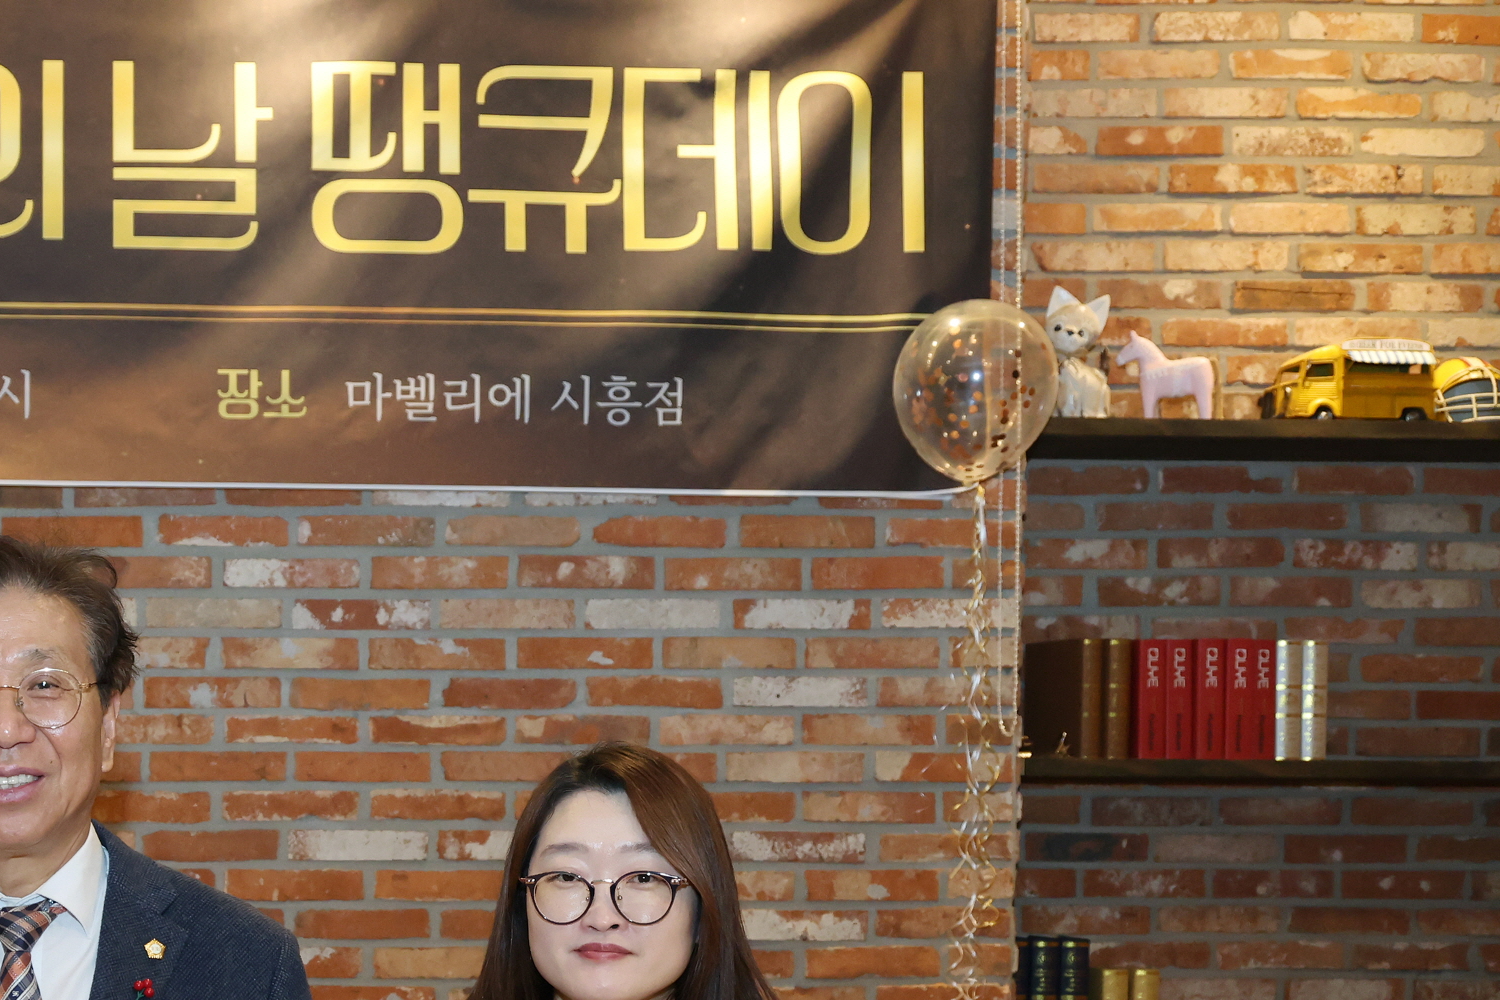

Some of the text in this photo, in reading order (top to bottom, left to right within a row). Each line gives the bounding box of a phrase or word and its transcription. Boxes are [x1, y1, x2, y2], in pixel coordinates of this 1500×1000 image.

[111, 59, 274, 252] 날
[311, 61, 926, 256] 땡큐데이
[216, 367, 686, 427] 장소 마벨리에 시흥점
